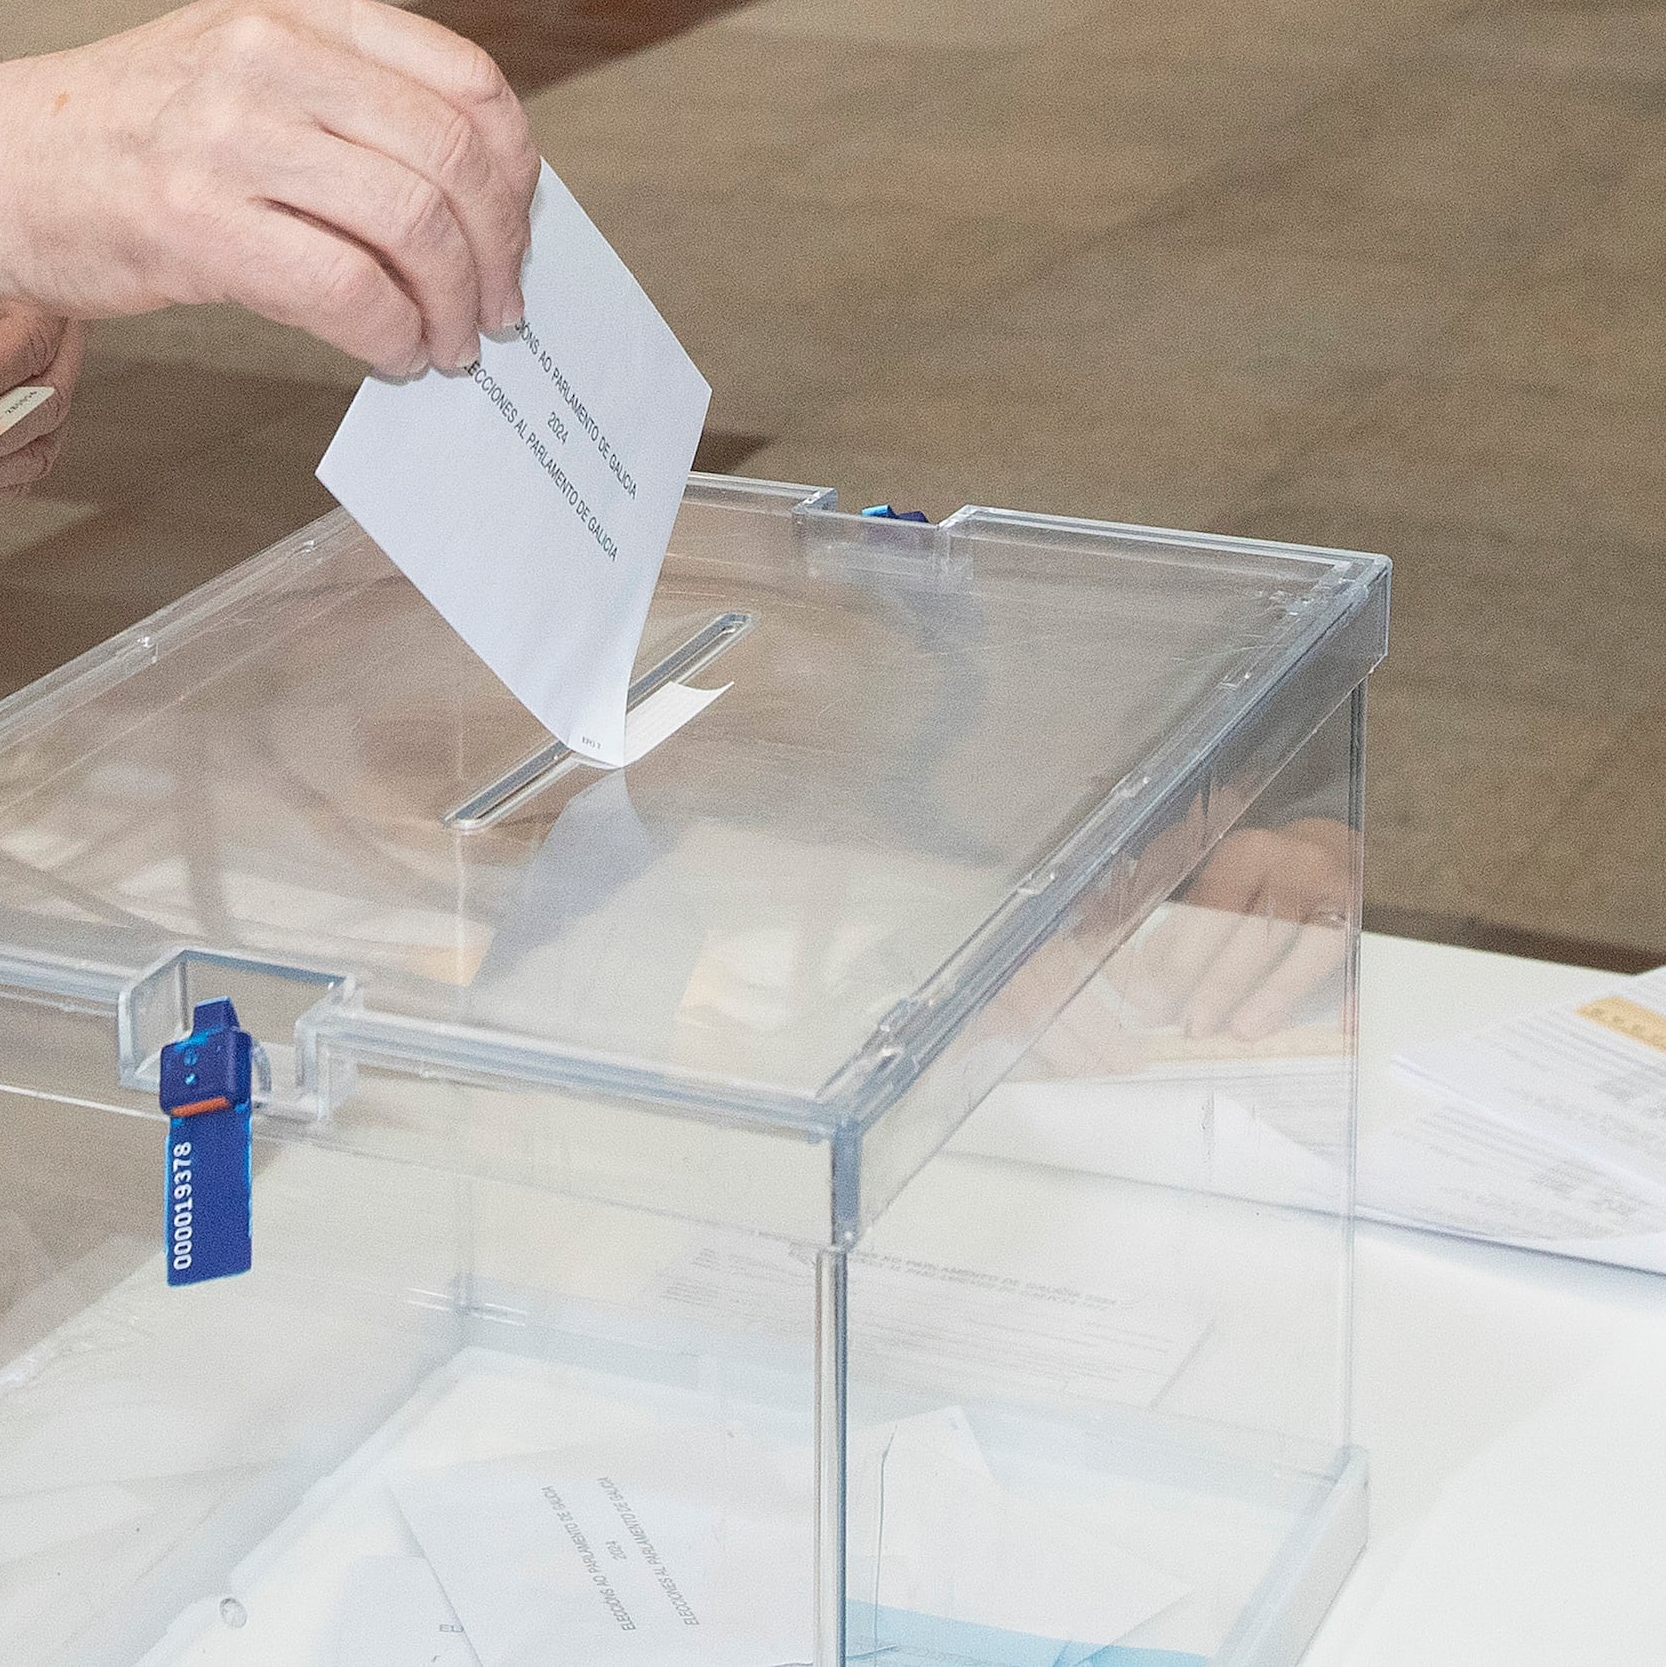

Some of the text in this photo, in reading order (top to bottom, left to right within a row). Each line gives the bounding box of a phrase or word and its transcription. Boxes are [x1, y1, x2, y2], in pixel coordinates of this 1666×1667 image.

[464, 360, 618, 562] ECCIONES AL PARLAMENTO DE GALICIA
[538, 351, 552, 373] AO
[551, 367, 599, 441] PARLAMENTO
[598, 436, 610, 460] DE
[609, 453, 637, 500] GALICIA
[547, 411, 569, 445] 2024
[173, 1140, 193, 1270] 000019378
